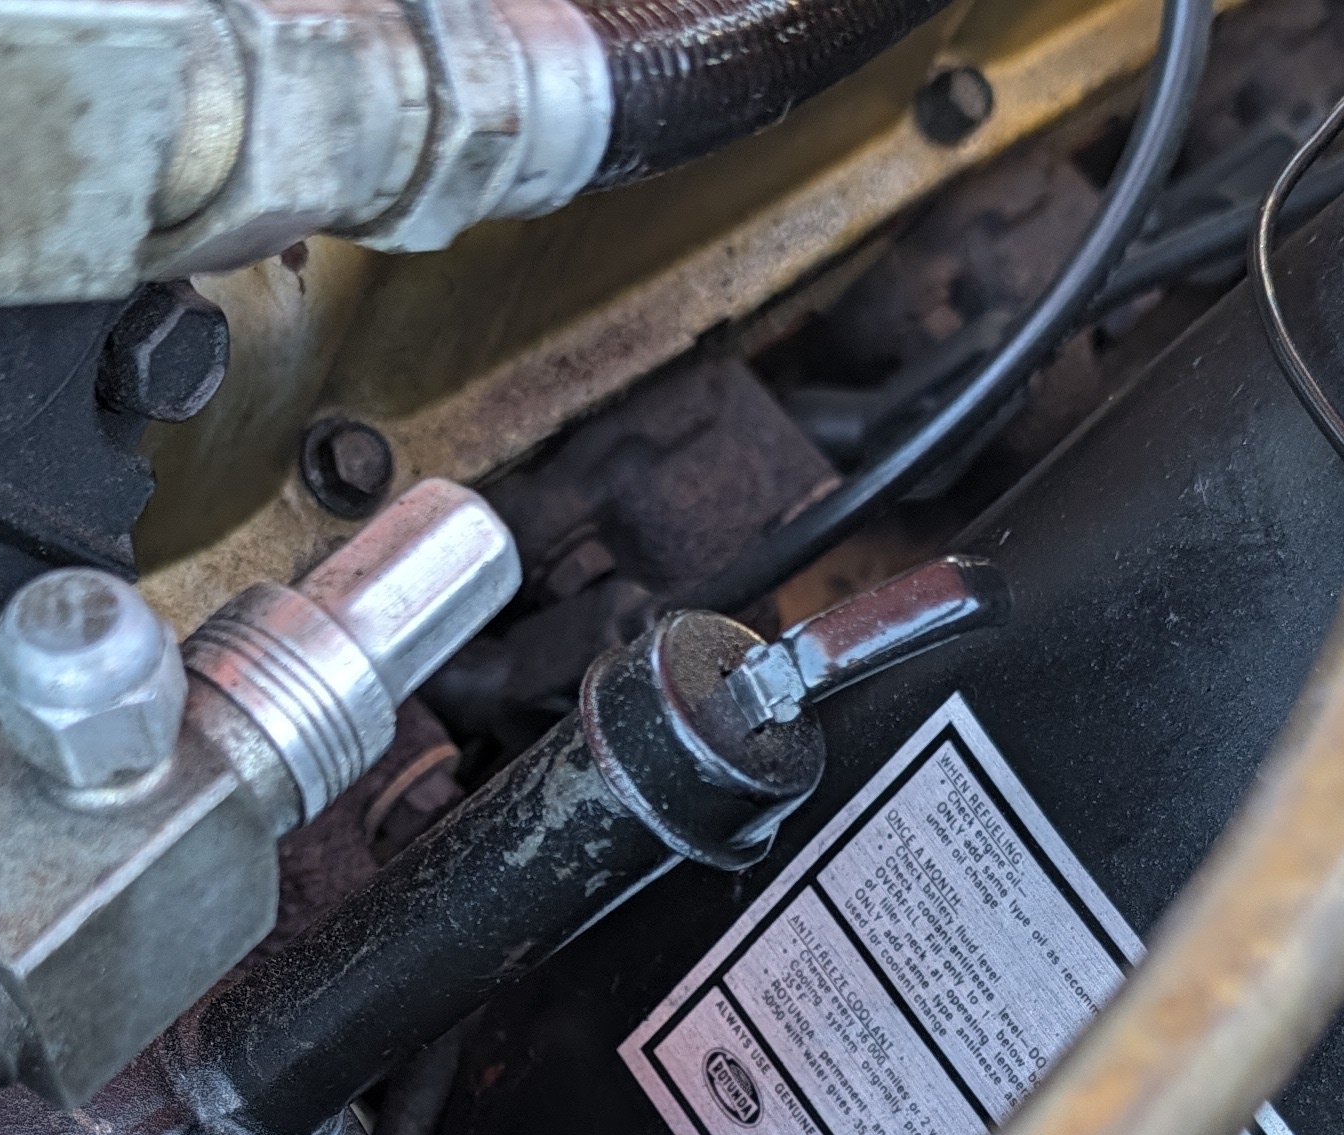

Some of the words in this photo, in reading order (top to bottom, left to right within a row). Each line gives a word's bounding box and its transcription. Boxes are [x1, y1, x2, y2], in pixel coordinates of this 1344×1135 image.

[884, 808, 916, 849] ONCE
[924, 812, 953, 847] under
[950, 847, 968, 865] oil
[939, 752, 971, 794] WHEN
[965, 792, 1022, 865] REFUELING
[946, 789, 975, 829] Check
[973, 828, 1006, 870] engine
[884, 854, 913, 894] Check
[894, 844, 923, 883] Check
[921, 881, 955, 926] battery
[954, 924, 979, 954] fluid
[935, 800, 965, 836] ONLY
[962, 838, 984, 863] add
[981, 864, 1008, 898] same
[1007, 898, 1031, 928] type
[1030, 928, 1048, 947] oil
[1045, 948, 1060, 966] as
[843, 898, 869, 929] used
[865, 927, 882, 947] for
[880, 948, 915, 993] coolant
[853, 887, 883, 922] ONLY
[882, 928, 904, 952] add
[903, 956, 930, 990] same
[930, 992, 954, 1022] type
[955, 1027, 1002, 1085] antifreeze
[1003, 1090, 1019, 1108] as
[863, 877, 878, 892] of
[878, 896, 902, 925] filler
[902, 931, 928, 962] neck
[929, 967, 943, 982] at
[944, 987, 990, 1047] operating
[923, 932, 943, 956] Fill
[941, 958, 965, 987] only
[965, 988, 979, 1006] to
[994, 1027, 1026, 1068] below
[714, 1000, 752, 1049] ALWAYS
[749, 1048, 771, 1075] USE
[760, 988, 786, 1021] 50/50
[783, 1020, 805, 1048] with
[802, 1048, 828, 1082] water
[824, 1082, 852, 1116] gives
[770, 978, 815, 1040] ROTUNDA
[817, 1049, 868, 1112] permanent
[788, 958, 823, 1007] Cooling
[824, 1010, 859, 1054] system
[860, 1059, 903, 1115] originally
[798, 948, 832, 994] Change
[829, 994, 856, 1028] every
[883, 1066, 910, 1101] miles
[908, 1101, 921, 1116] or
[846, 990, 894, 1054] COOLANT
[711, 1060, 752, 1117] ROTUNDA
